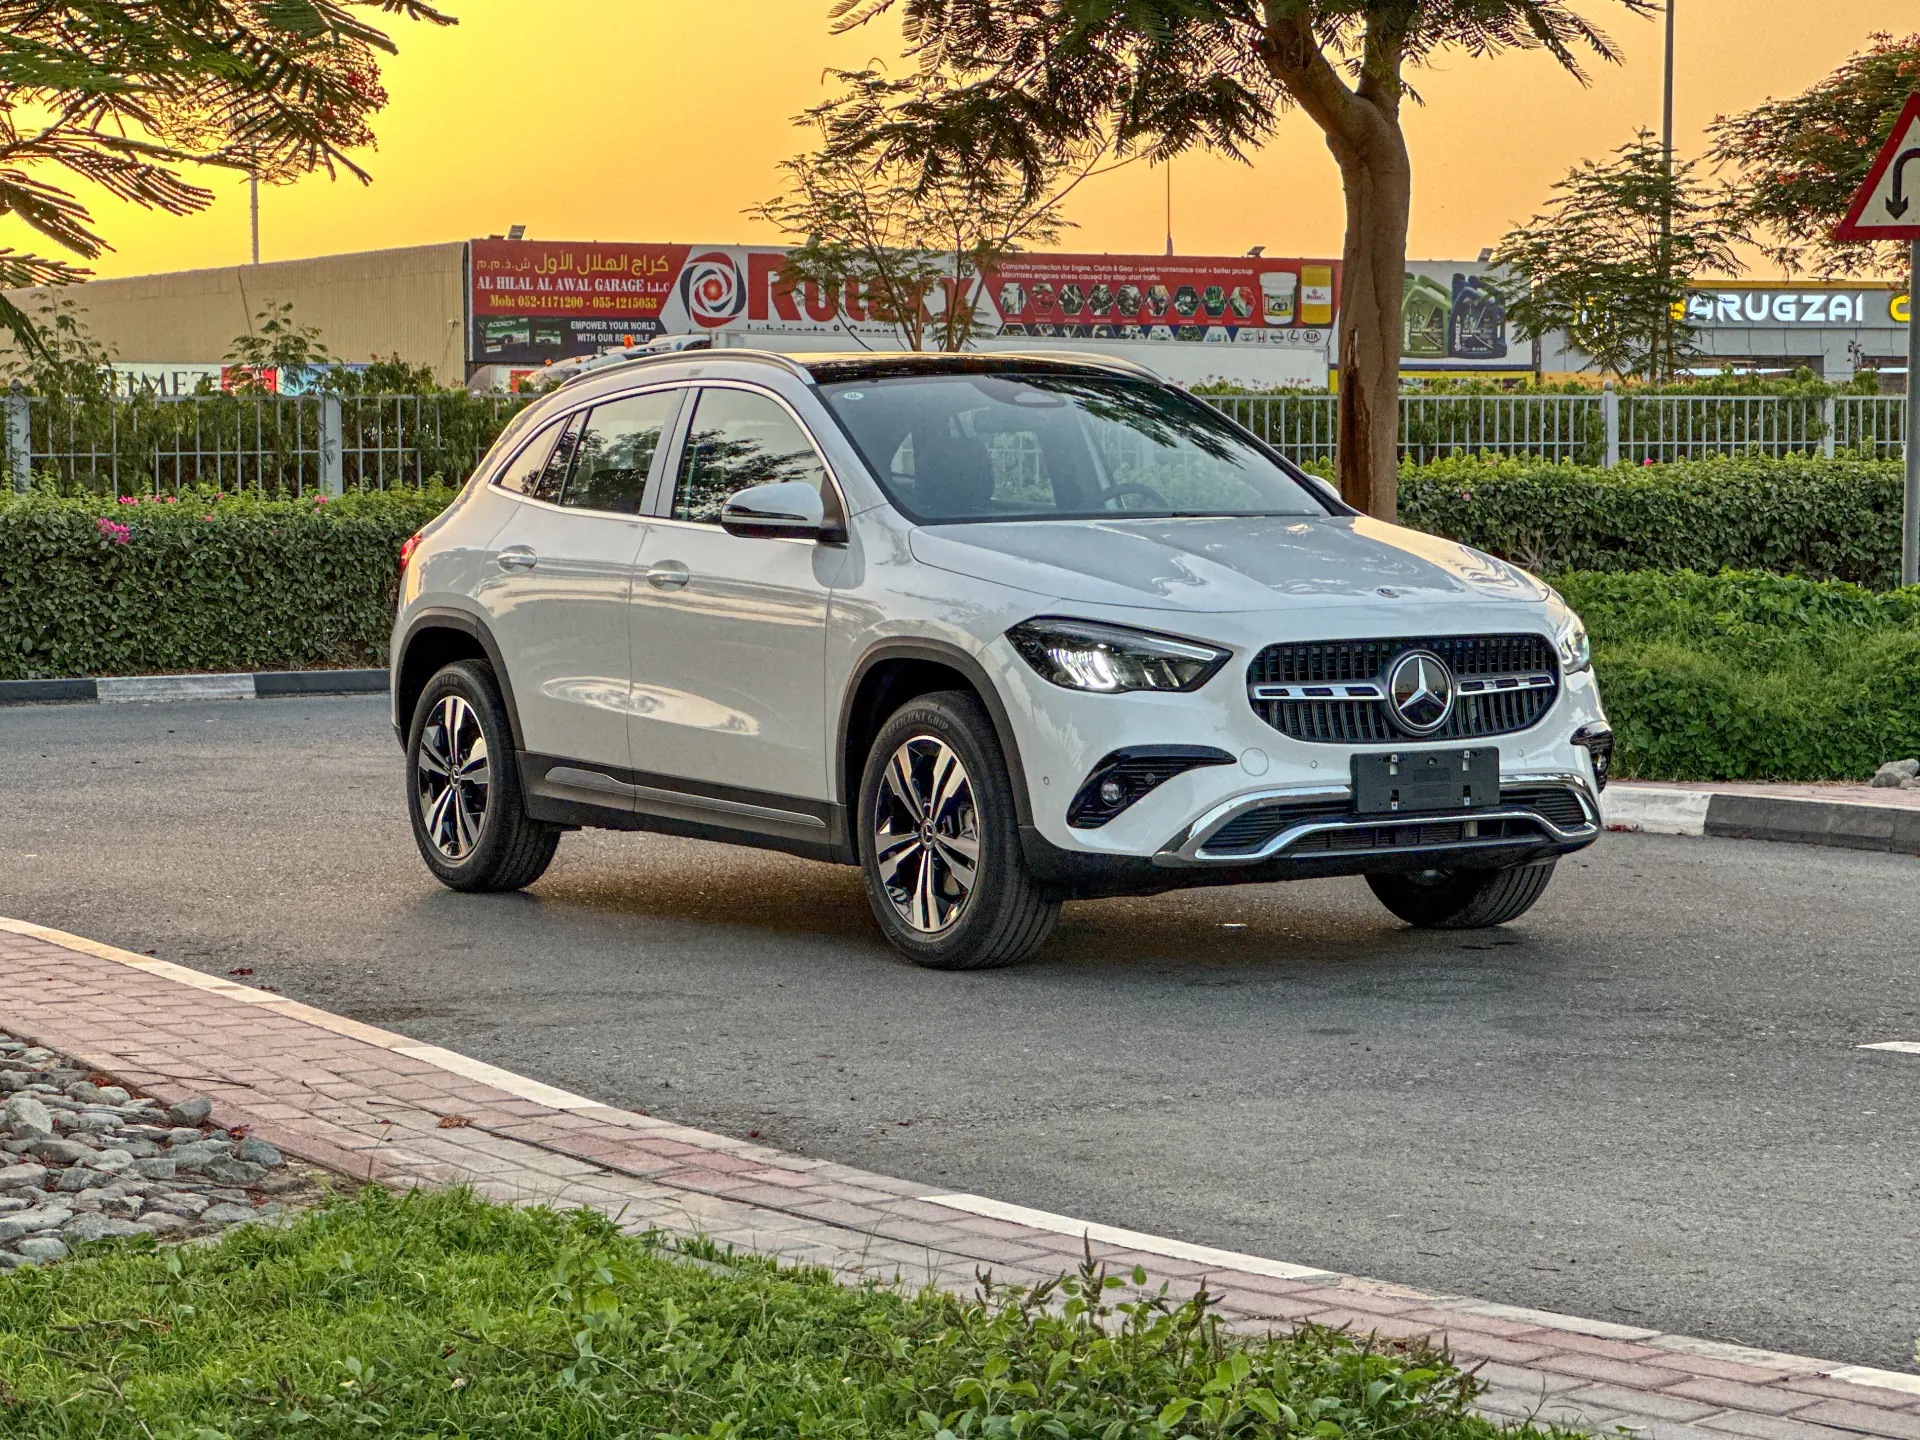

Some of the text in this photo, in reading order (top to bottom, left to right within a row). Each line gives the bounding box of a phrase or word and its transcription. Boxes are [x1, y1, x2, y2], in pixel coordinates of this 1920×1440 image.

[577, 253, 628, 275] الهلال
[632, 254, 669, 276] كراج
[1001, 263, 1031, 272] Complete
[1031, 264, 1062, 272] protection
[1093, 264, 1112, 272] Clutch
[1156, 266, 1194, 274] maintenance
[1194, 266, 1208, 274] cost
[1231, 268, 1254, 276] pickup
[1001, 272, 1033, 280] Minimizes
[1034, 273, 1059, 281] engines
[476, 276, 670, 293] AL HILAL AL AWAL GARAGE L.L.C
[490, 294, 515, 308] Mob:
[518, 296, 584, 308] 052-1171200
[592, 296, 657, 310] 055-1215053
[570, 320, 656, 331] EMPOWER YOUR WORLD
[576, 333, 650, 343] WITH OUR REABLE
